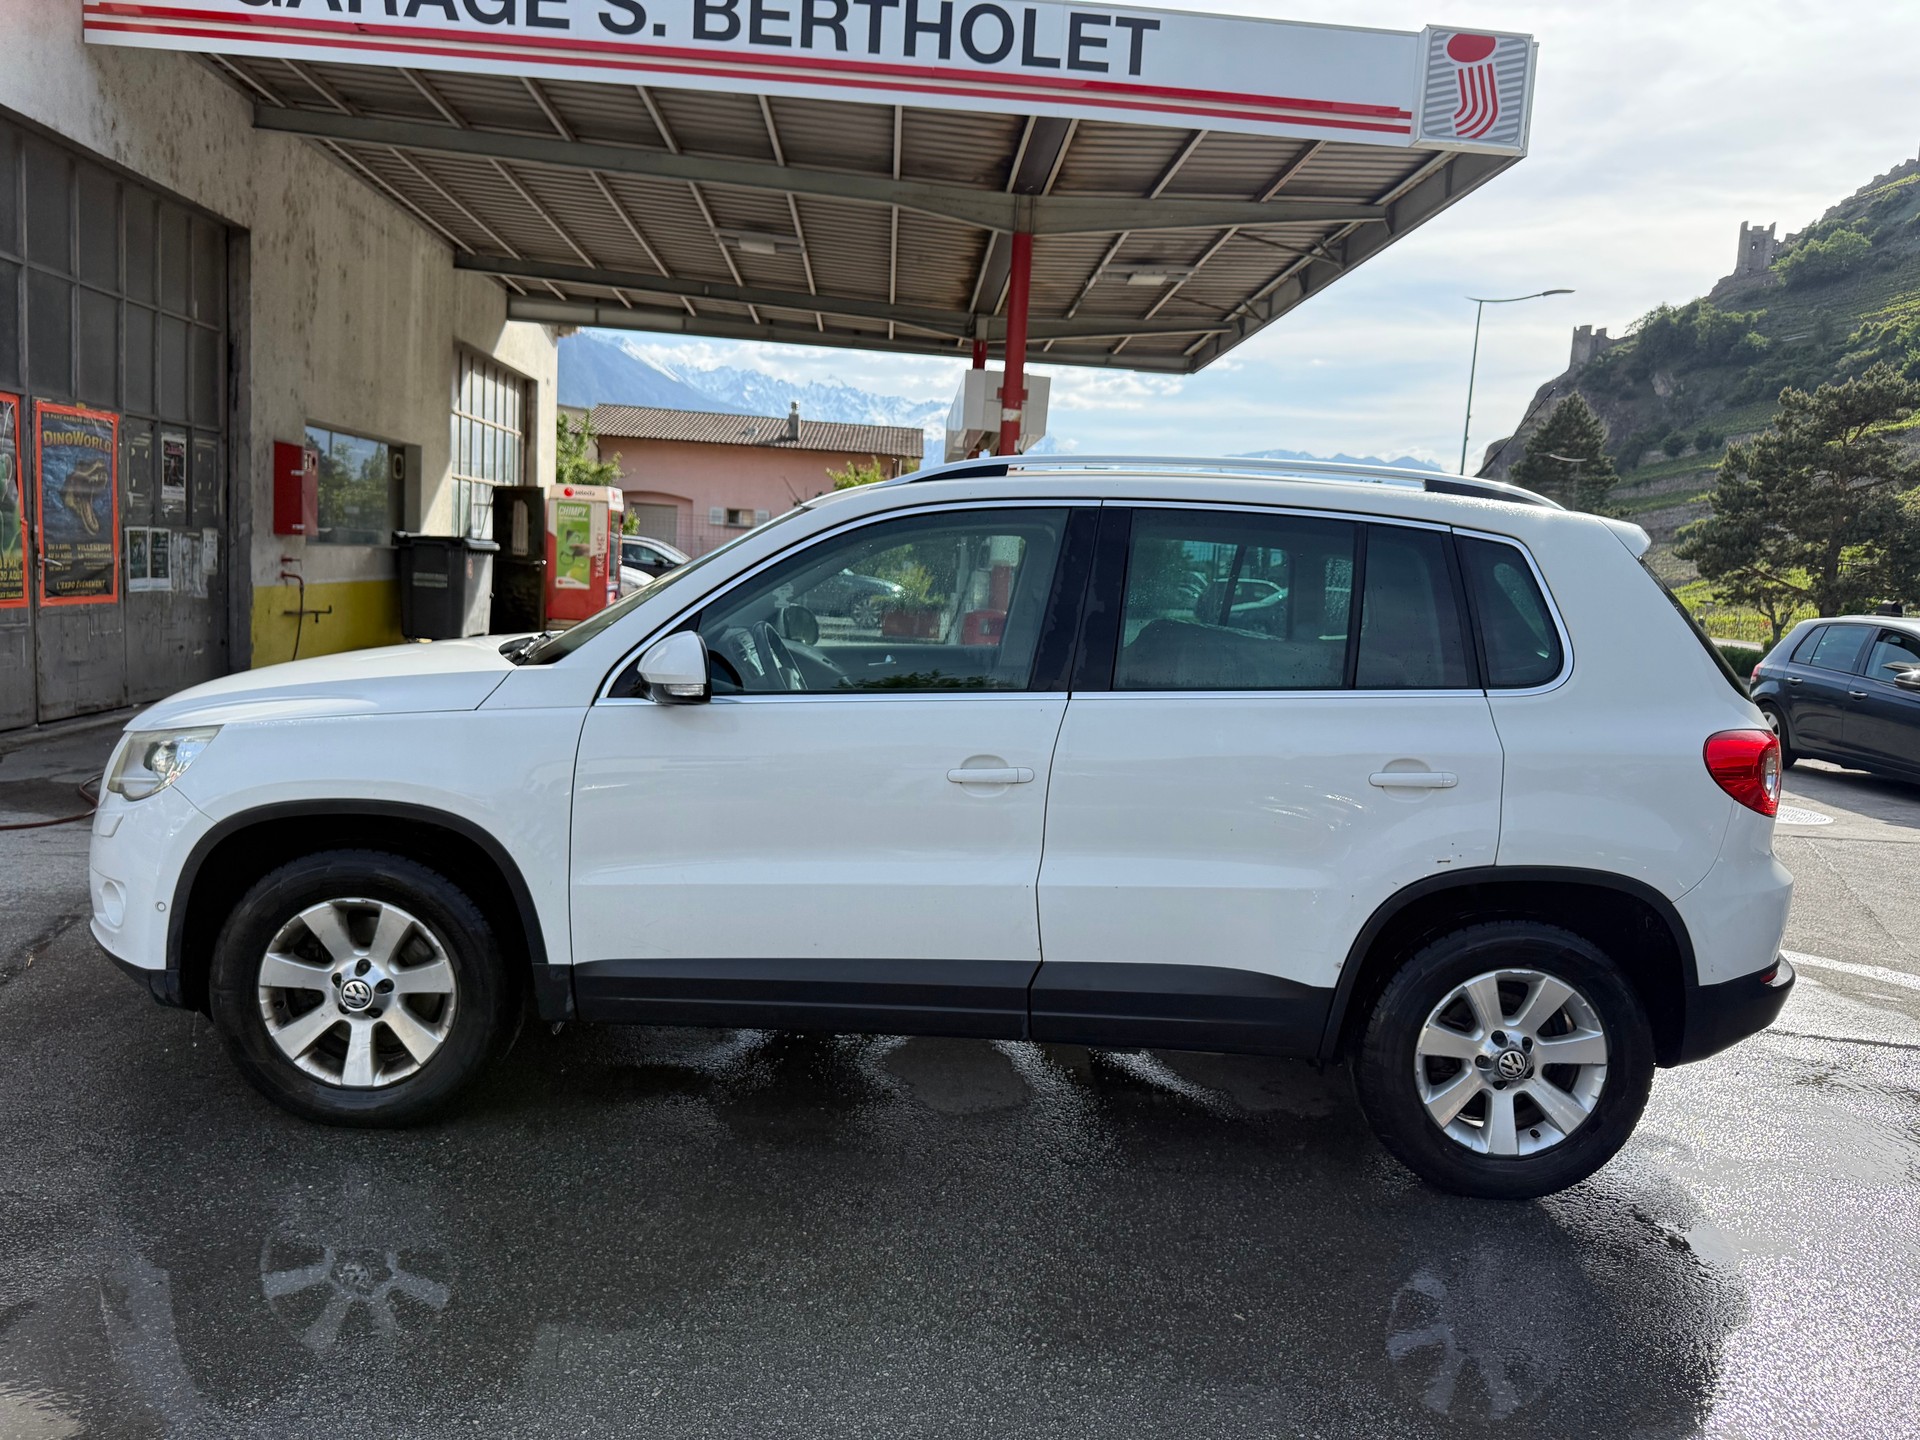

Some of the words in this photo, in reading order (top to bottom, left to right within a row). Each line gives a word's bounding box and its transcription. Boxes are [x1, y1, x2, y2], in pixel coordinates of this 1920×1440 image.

[598, 0, 666, 37] S.
[692, 0, 1161, 77] BERTHOLET
[559, 505, 587, 516] CHIMPY
